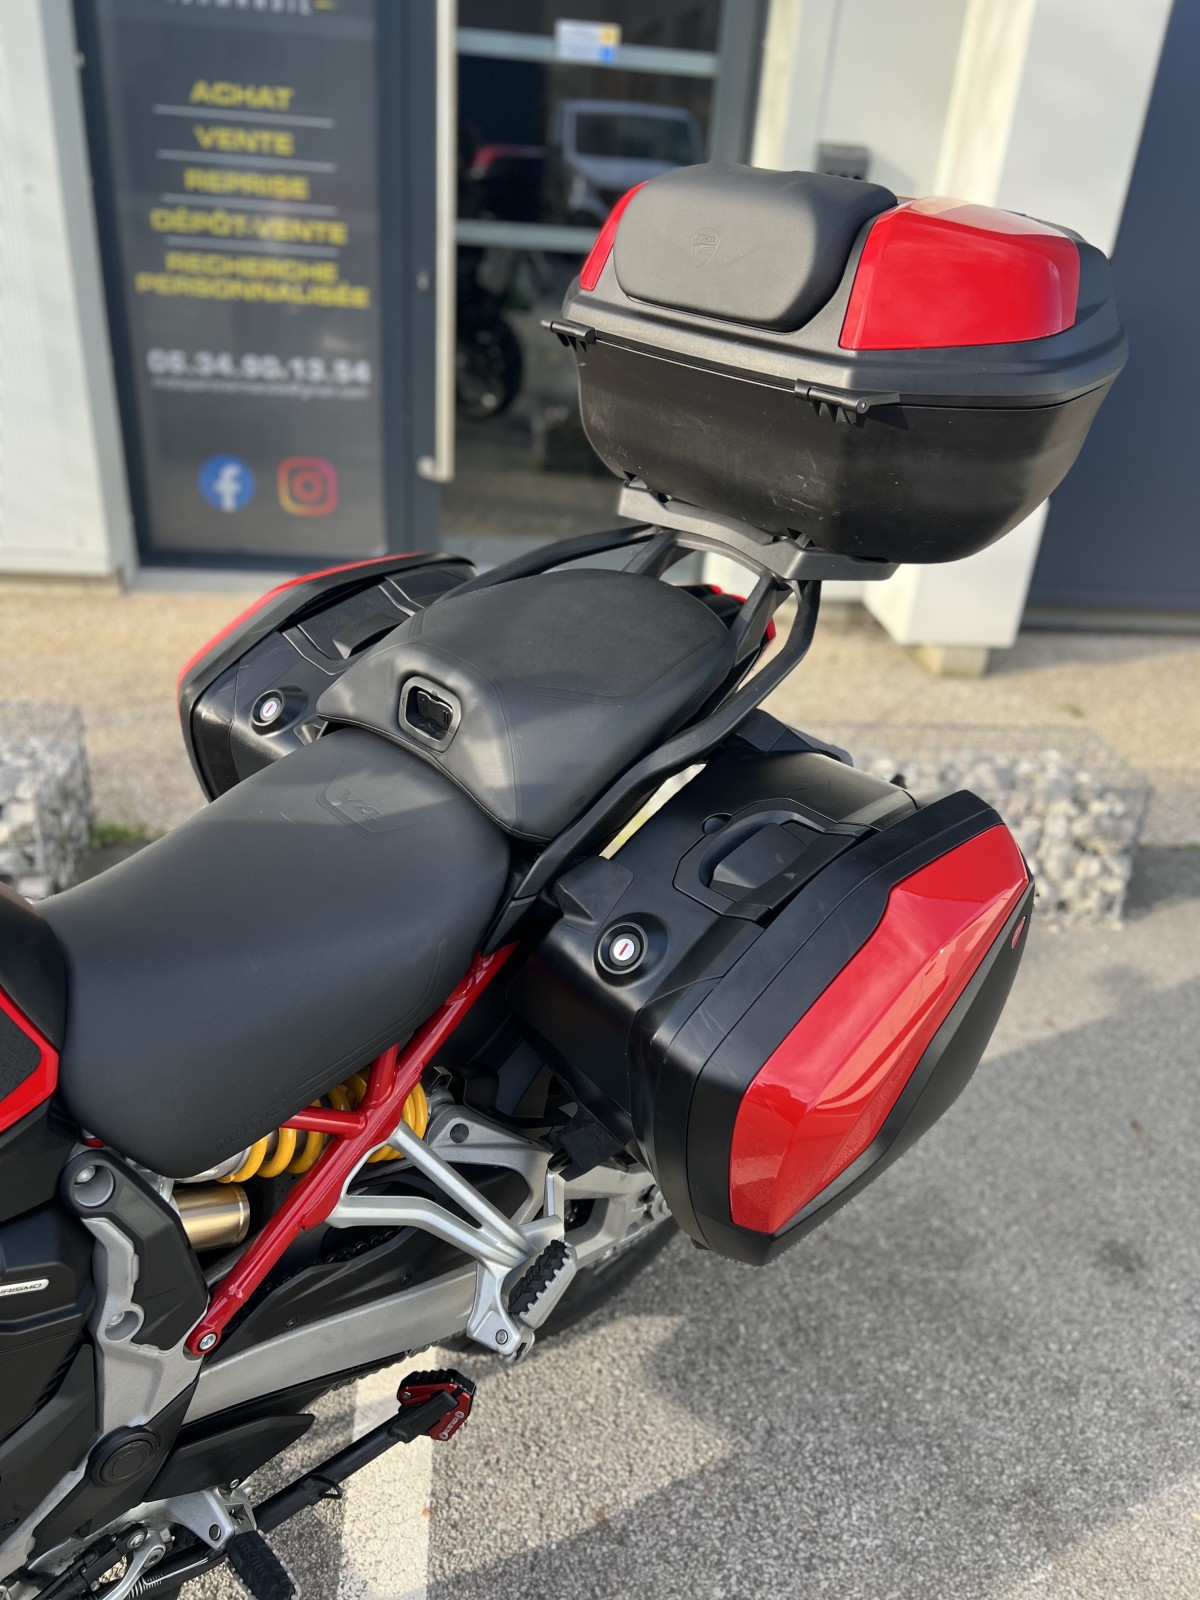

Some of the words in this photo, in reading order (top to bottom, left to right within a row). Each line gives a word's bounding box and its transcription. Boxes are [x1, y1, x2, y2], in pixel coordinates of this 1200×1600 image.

[189, 80, 297, 111] ACHAT
[193, 126, 295, 156] VENTE
[183, 168, 310, 201] REPRISE
[165, 251, 339, 283] RECHERCHE
[135, 271, 371, 309] PERSONNALISÉE
